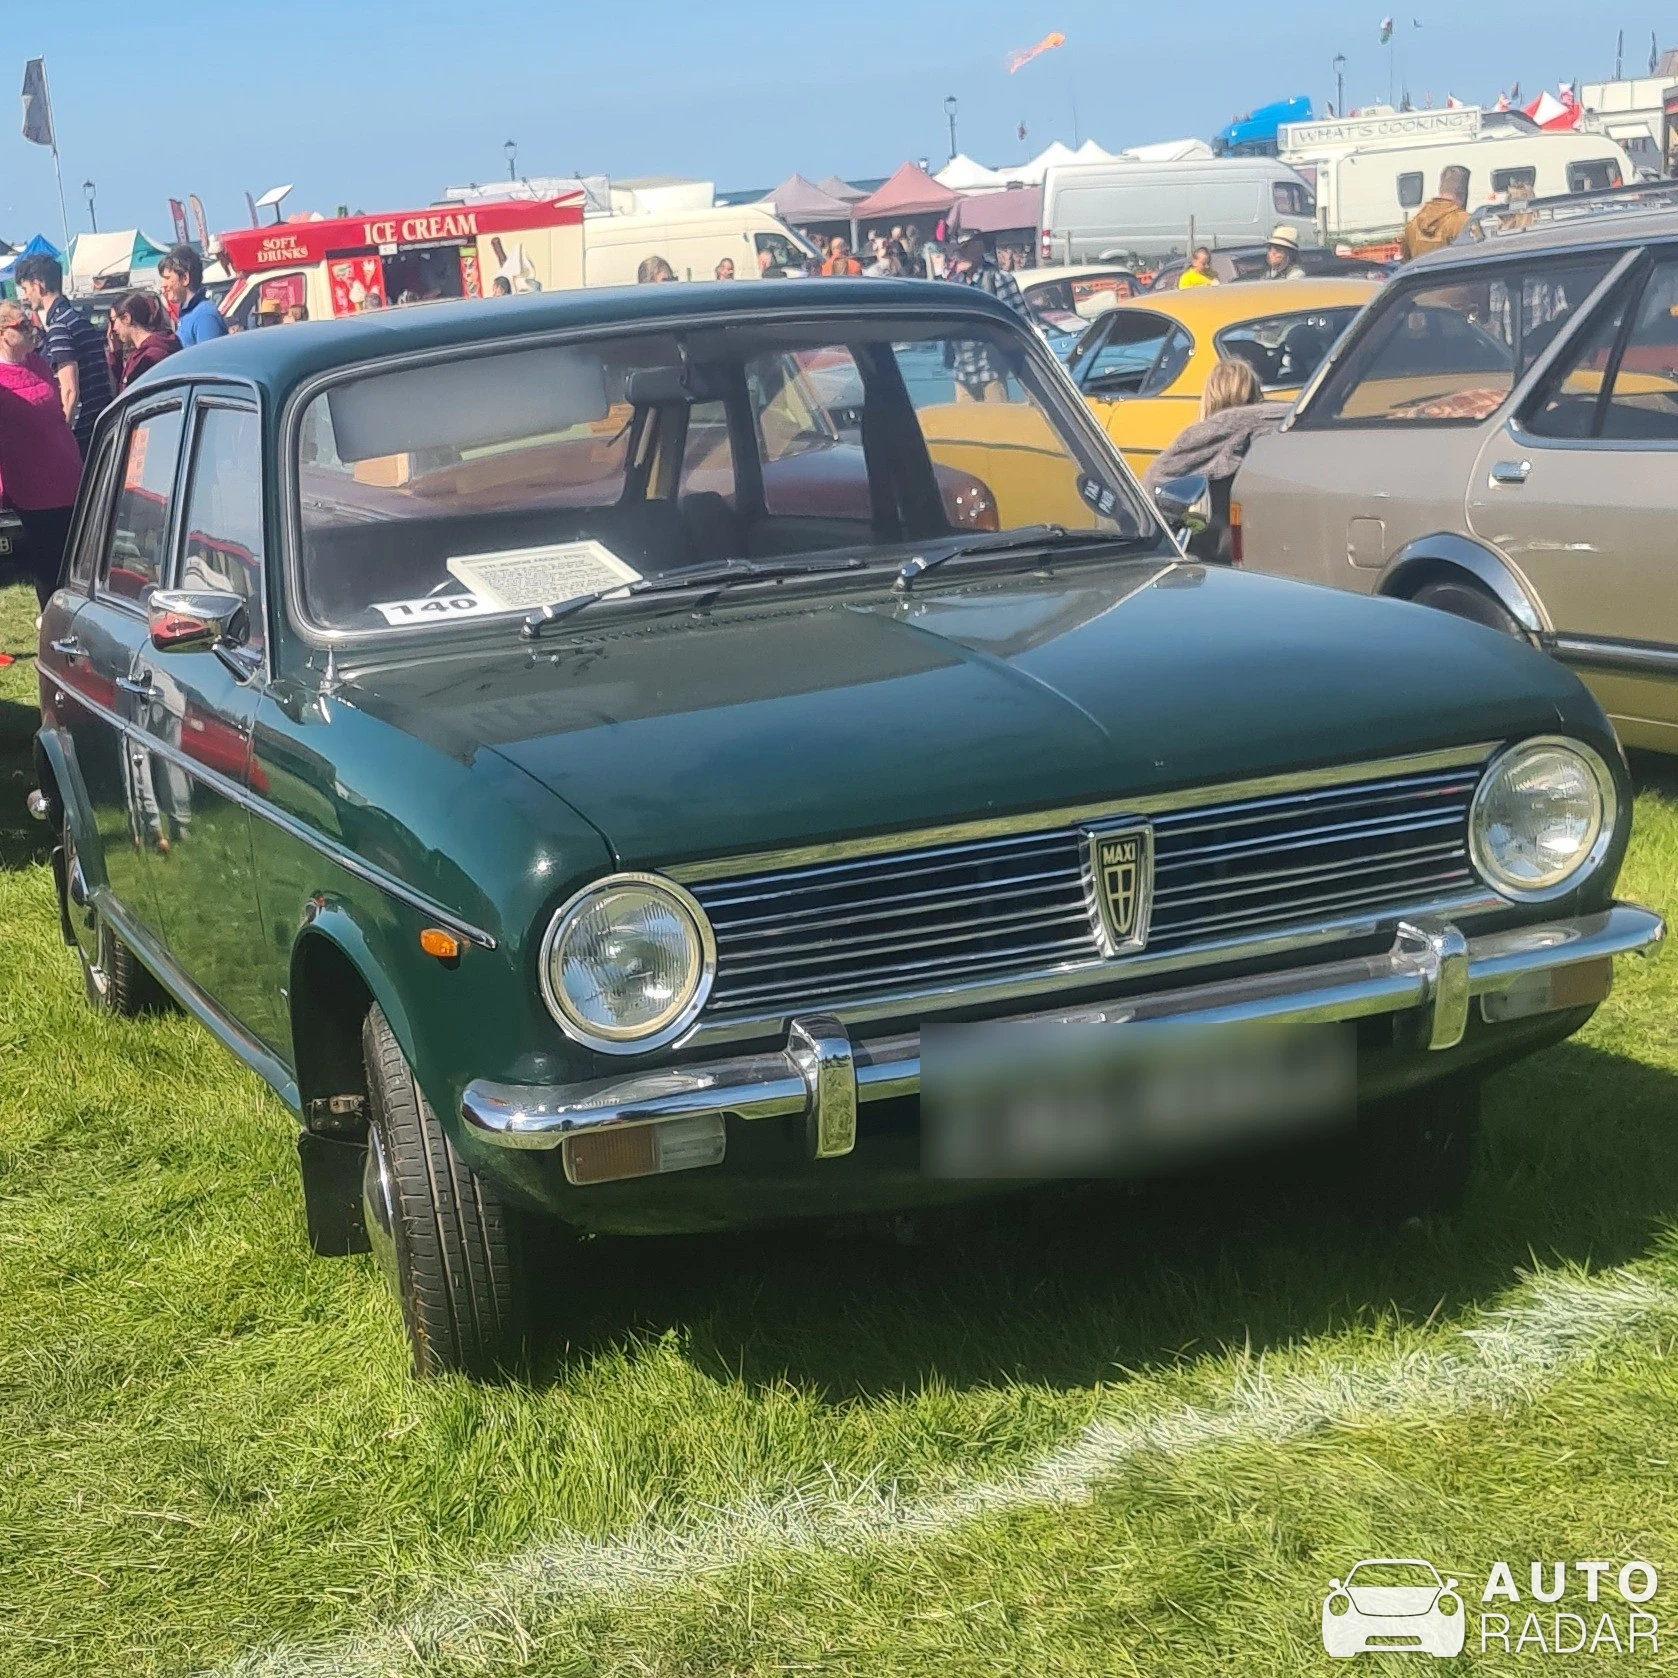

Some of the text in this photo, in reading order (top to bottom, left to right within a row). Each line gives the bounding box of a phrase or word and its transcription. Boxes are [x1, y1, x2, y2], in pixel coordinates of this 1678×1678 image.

[1299, 123, 1374, 143] WHAT'S
[363, 220, 397, 245] ICE
[402, 213, 478, 241] CREAM
[262, 235, 297, 251] SOFT
[257, 246, 308, 263] DRINKS
[389, 598, 478, 616] 140
[1102, 841, 1136, 866] MAXI
